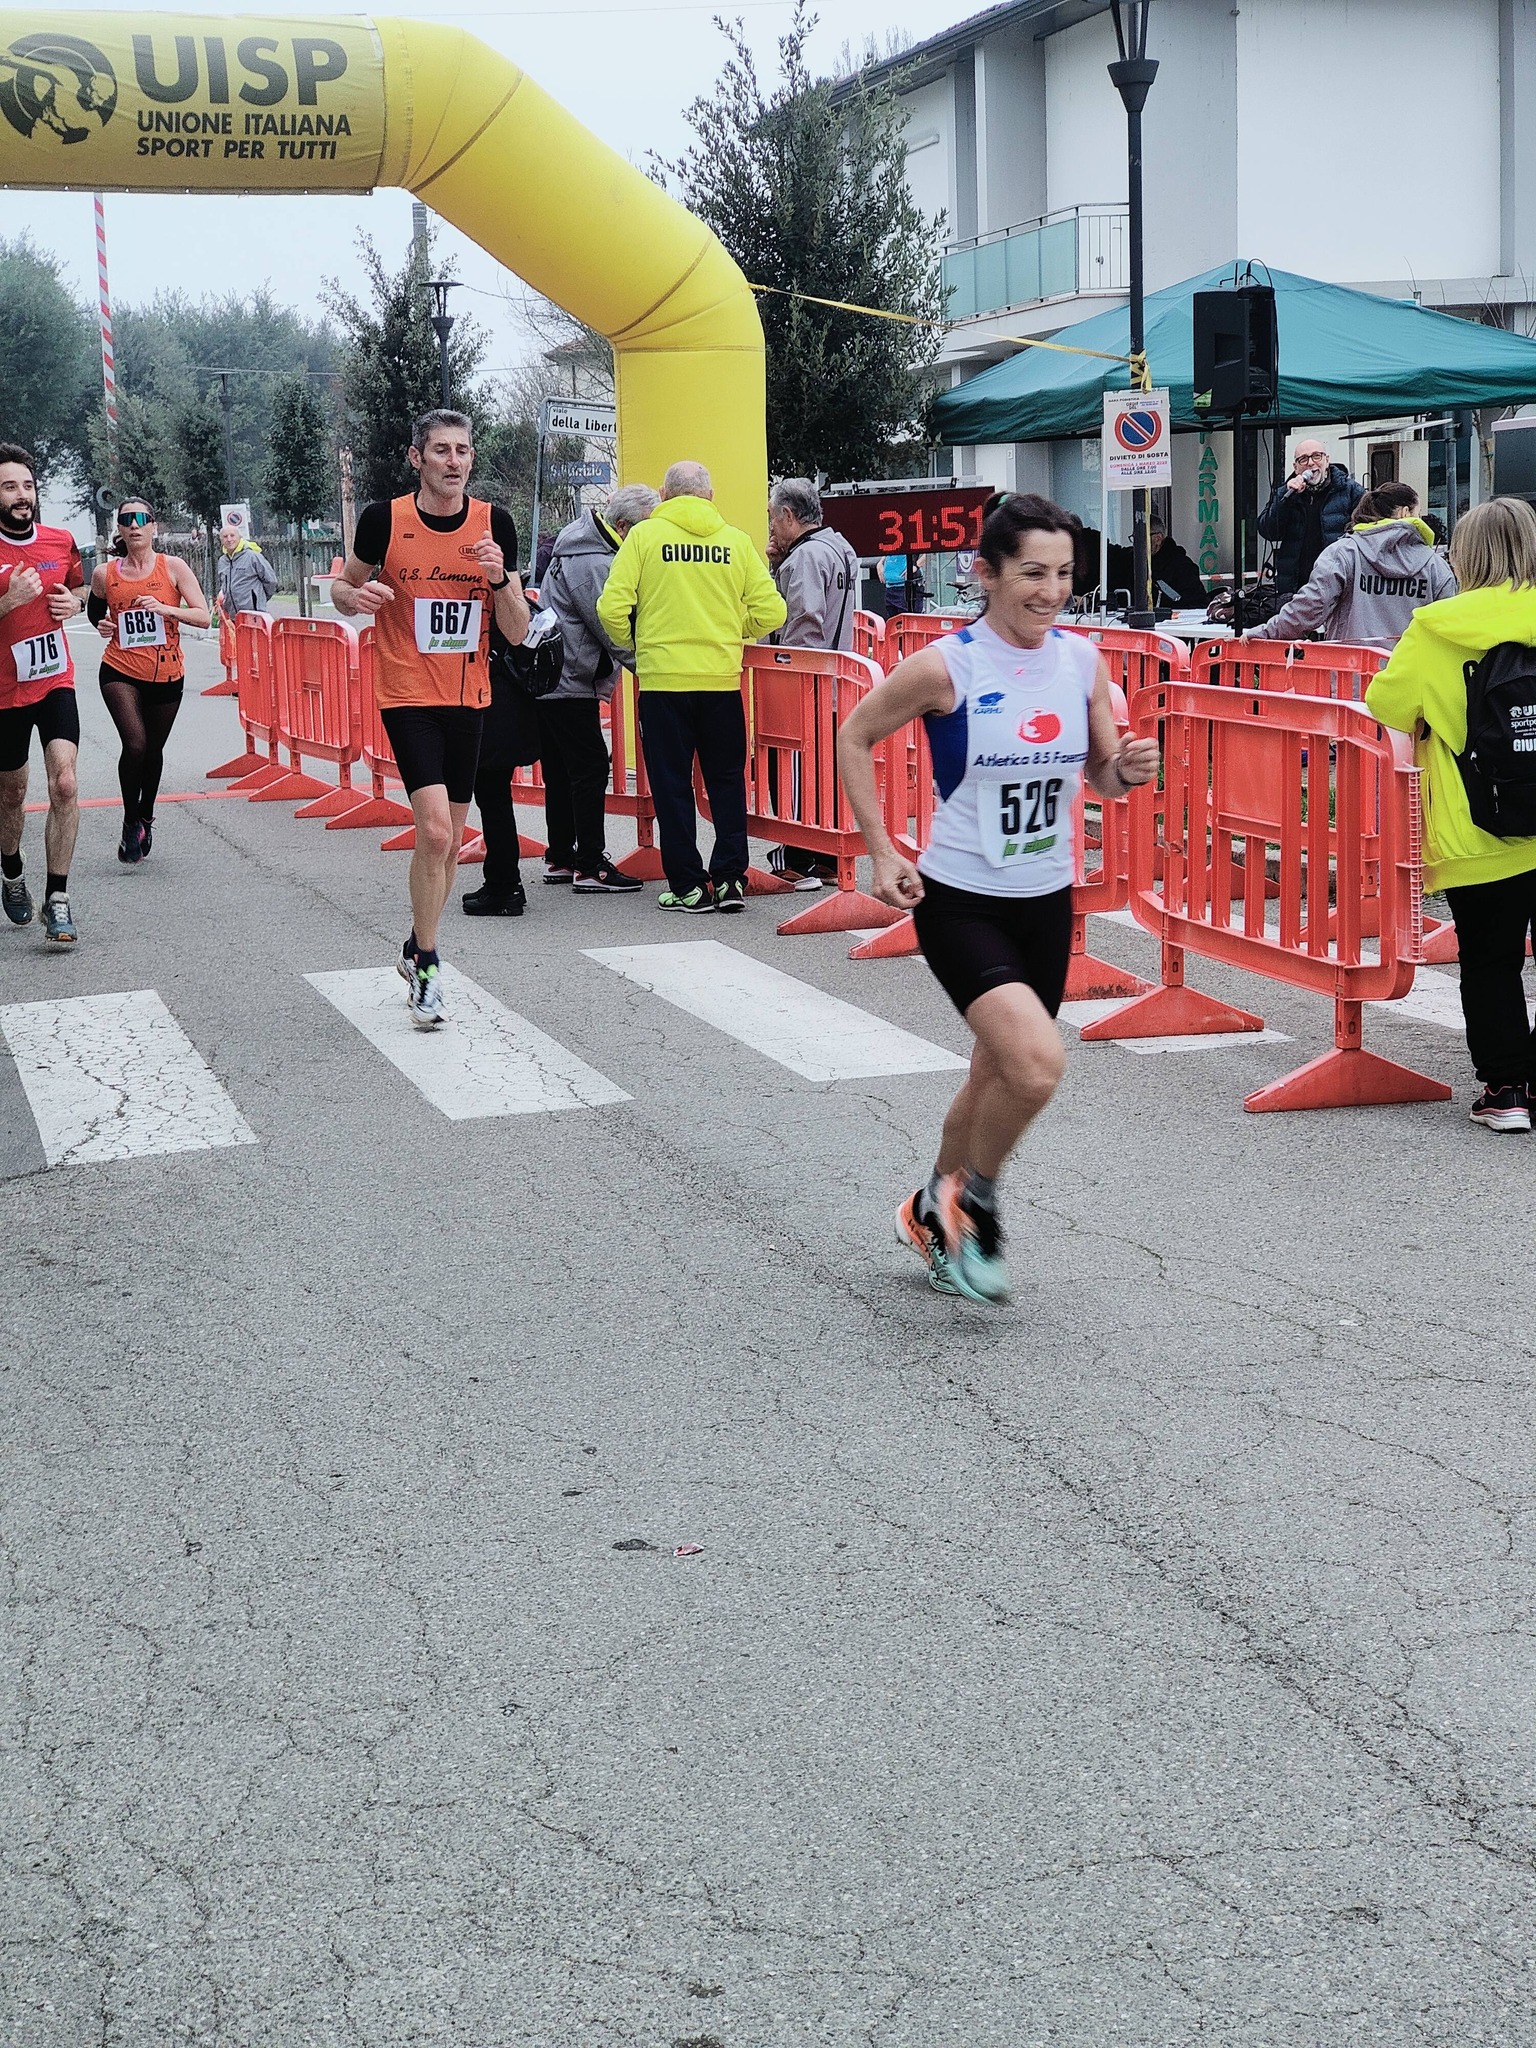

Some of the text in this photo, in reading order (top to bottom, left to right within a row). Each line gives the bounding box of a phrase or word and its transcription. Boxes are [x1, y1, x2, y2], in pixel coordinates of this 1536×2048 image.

[132, 35, 348, 106] UISP
[137, 110, 352, 136] UNIONE ITALIANA
[136, 137, 337, 159] SPORT PER TUTTI
[552, 415, 616, 433] della Libert
[878, 505, 984, 551] 31:51
[662, 543, 731, 564] GIUDICE
[426, 565, 483, 584] Lamone
[1359, 573, 1428, 599] GIUDICE
[124, 610, 157, 635] 683
[430, 601, 472, 635] 667
[24, 633, 59, 666] 776
[974, 753, 1030, 767] Atletica
[1001, 778, 1063, 836] 526
